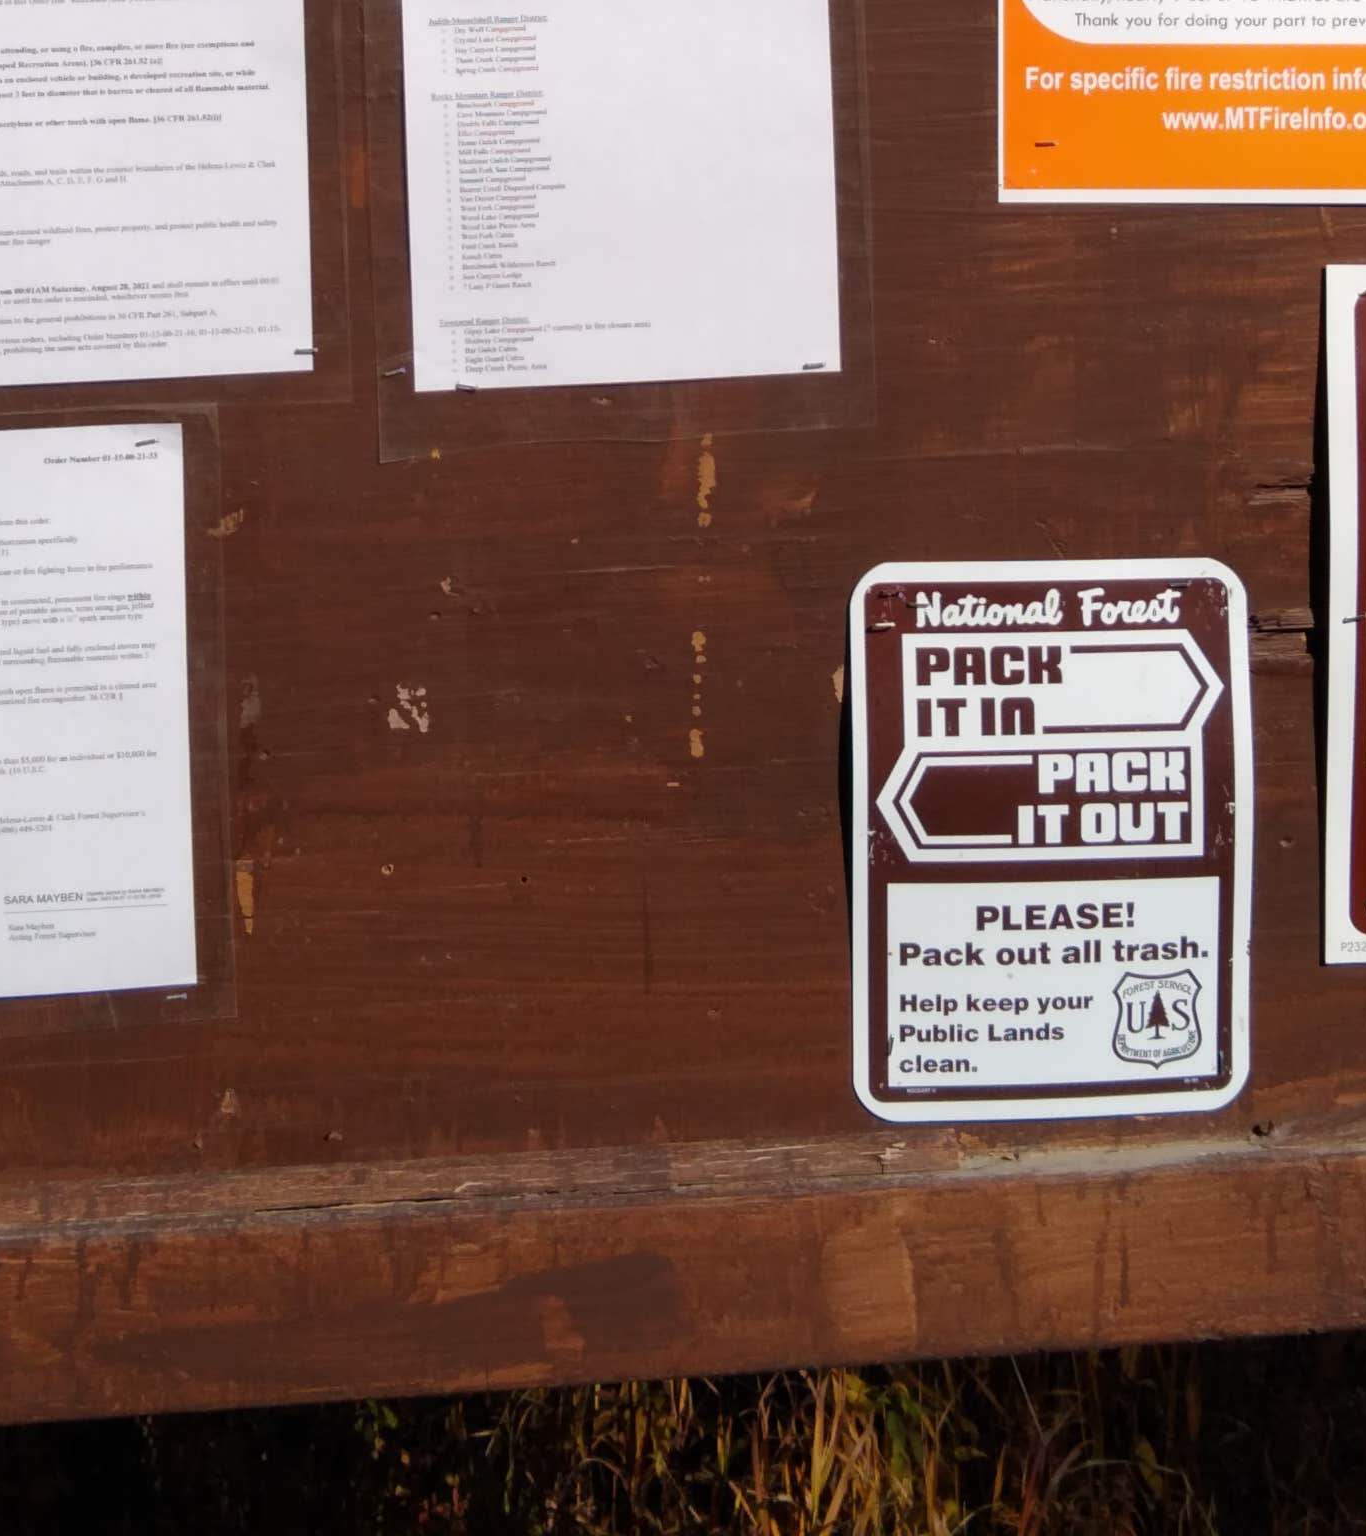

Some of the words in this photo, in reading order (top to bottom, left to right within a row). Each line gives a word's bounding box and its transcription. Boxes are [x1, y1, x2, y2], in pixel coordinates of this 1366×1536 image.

[1025, 66, 1064, 90] For
[1070, 66, 1159, 95] specific
[1165, 66, 1203, 90] fire
[1209, 67, 1326, 91] restriction
[916, 588, 1063, 628] National
[1077, 587, 1181, 626] Forest
[916, 646, 1062, 686] PACK
[917, 698, 967, 737] IT
[981, 697, 1035, 736] IN
[1038, 752, 1185, 794] PACK
[1018, 805, 1069, 844] IT
[1081, 803, 1188, 844] OUT
[4, 895, 34, 906] SARA
[37, 892, 83, 903] MAYBEN
[976, 902, 1134, 931] PLEASE!
[900, 942, 984, 966] Pack
[996, 942, 1051, 965] out
[1062, 940, 1101, 964] all
[1113, 936, 1208, 962] trash.
[1123, 980, 1155, 998] FOREST
[900, 994, 958, 1016] Help
[966, 994, 1029, 1015] keep
[1037, 996, 1093, 1014] your
[900, 1024, 978, 1042] Public
[988, 1023, 1064, 1041] Lands
[899, 1055, 977, 1073] clean.
